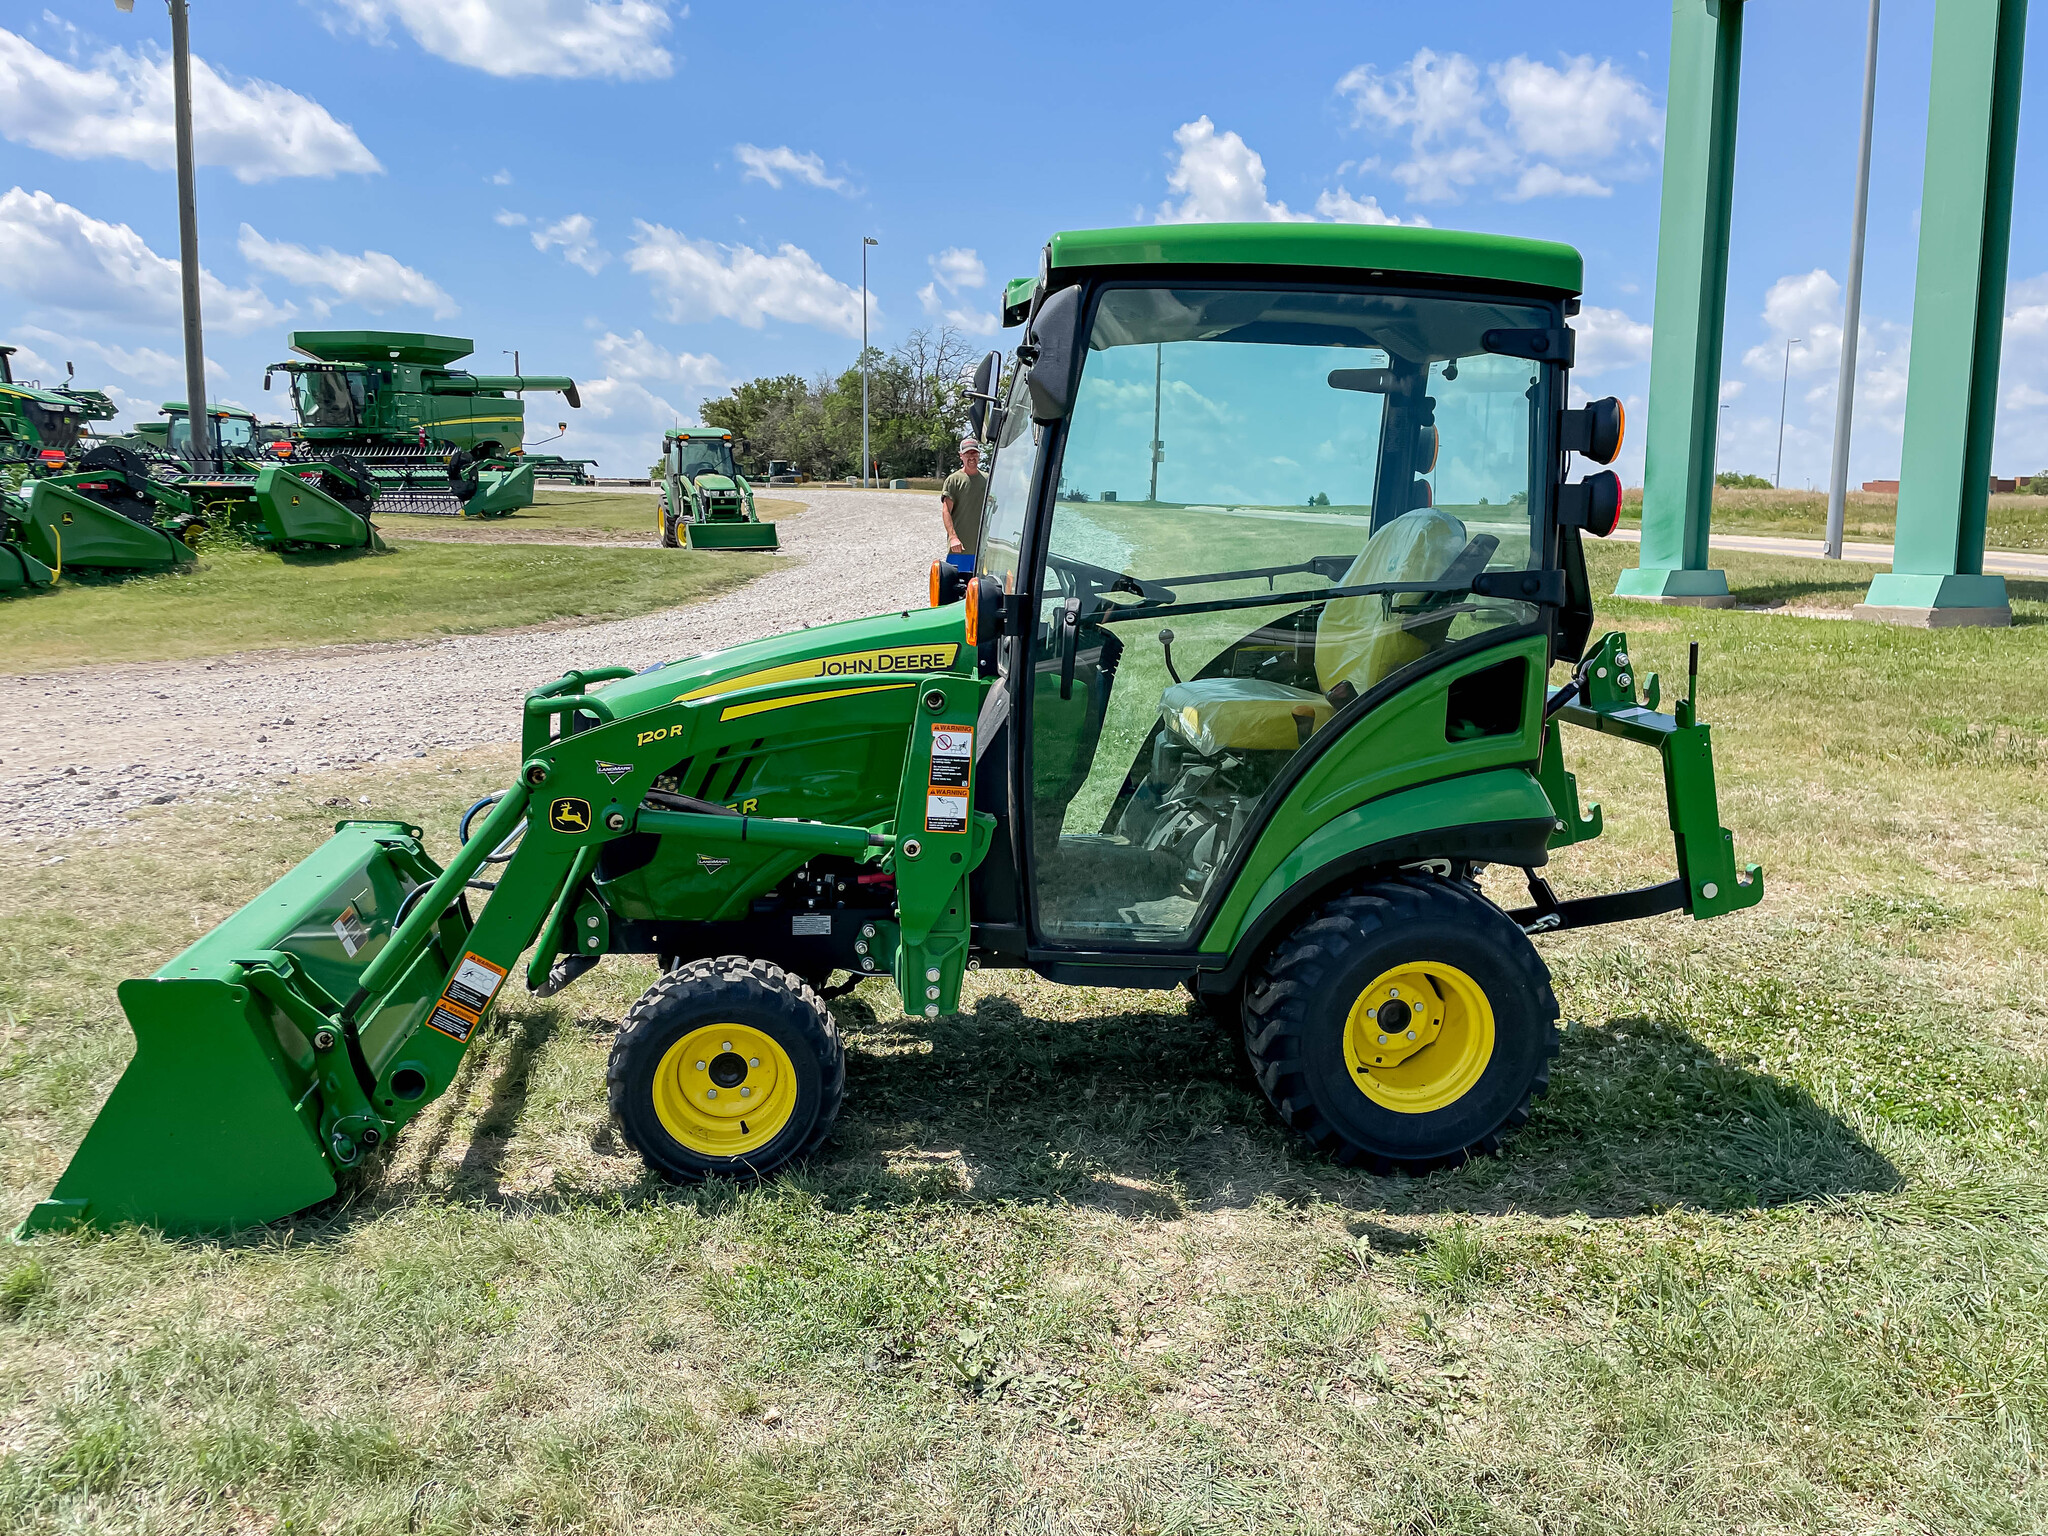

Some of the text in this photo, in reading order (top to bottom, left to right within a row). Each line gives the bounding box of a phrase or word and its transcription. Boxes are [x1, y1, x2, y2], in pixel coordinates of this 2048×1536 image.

[814, 652, 946, 678] JOHN DEERE
[475, 957, 502, 973] WARNING
[448, 1005, 475, 1021] WARNING
